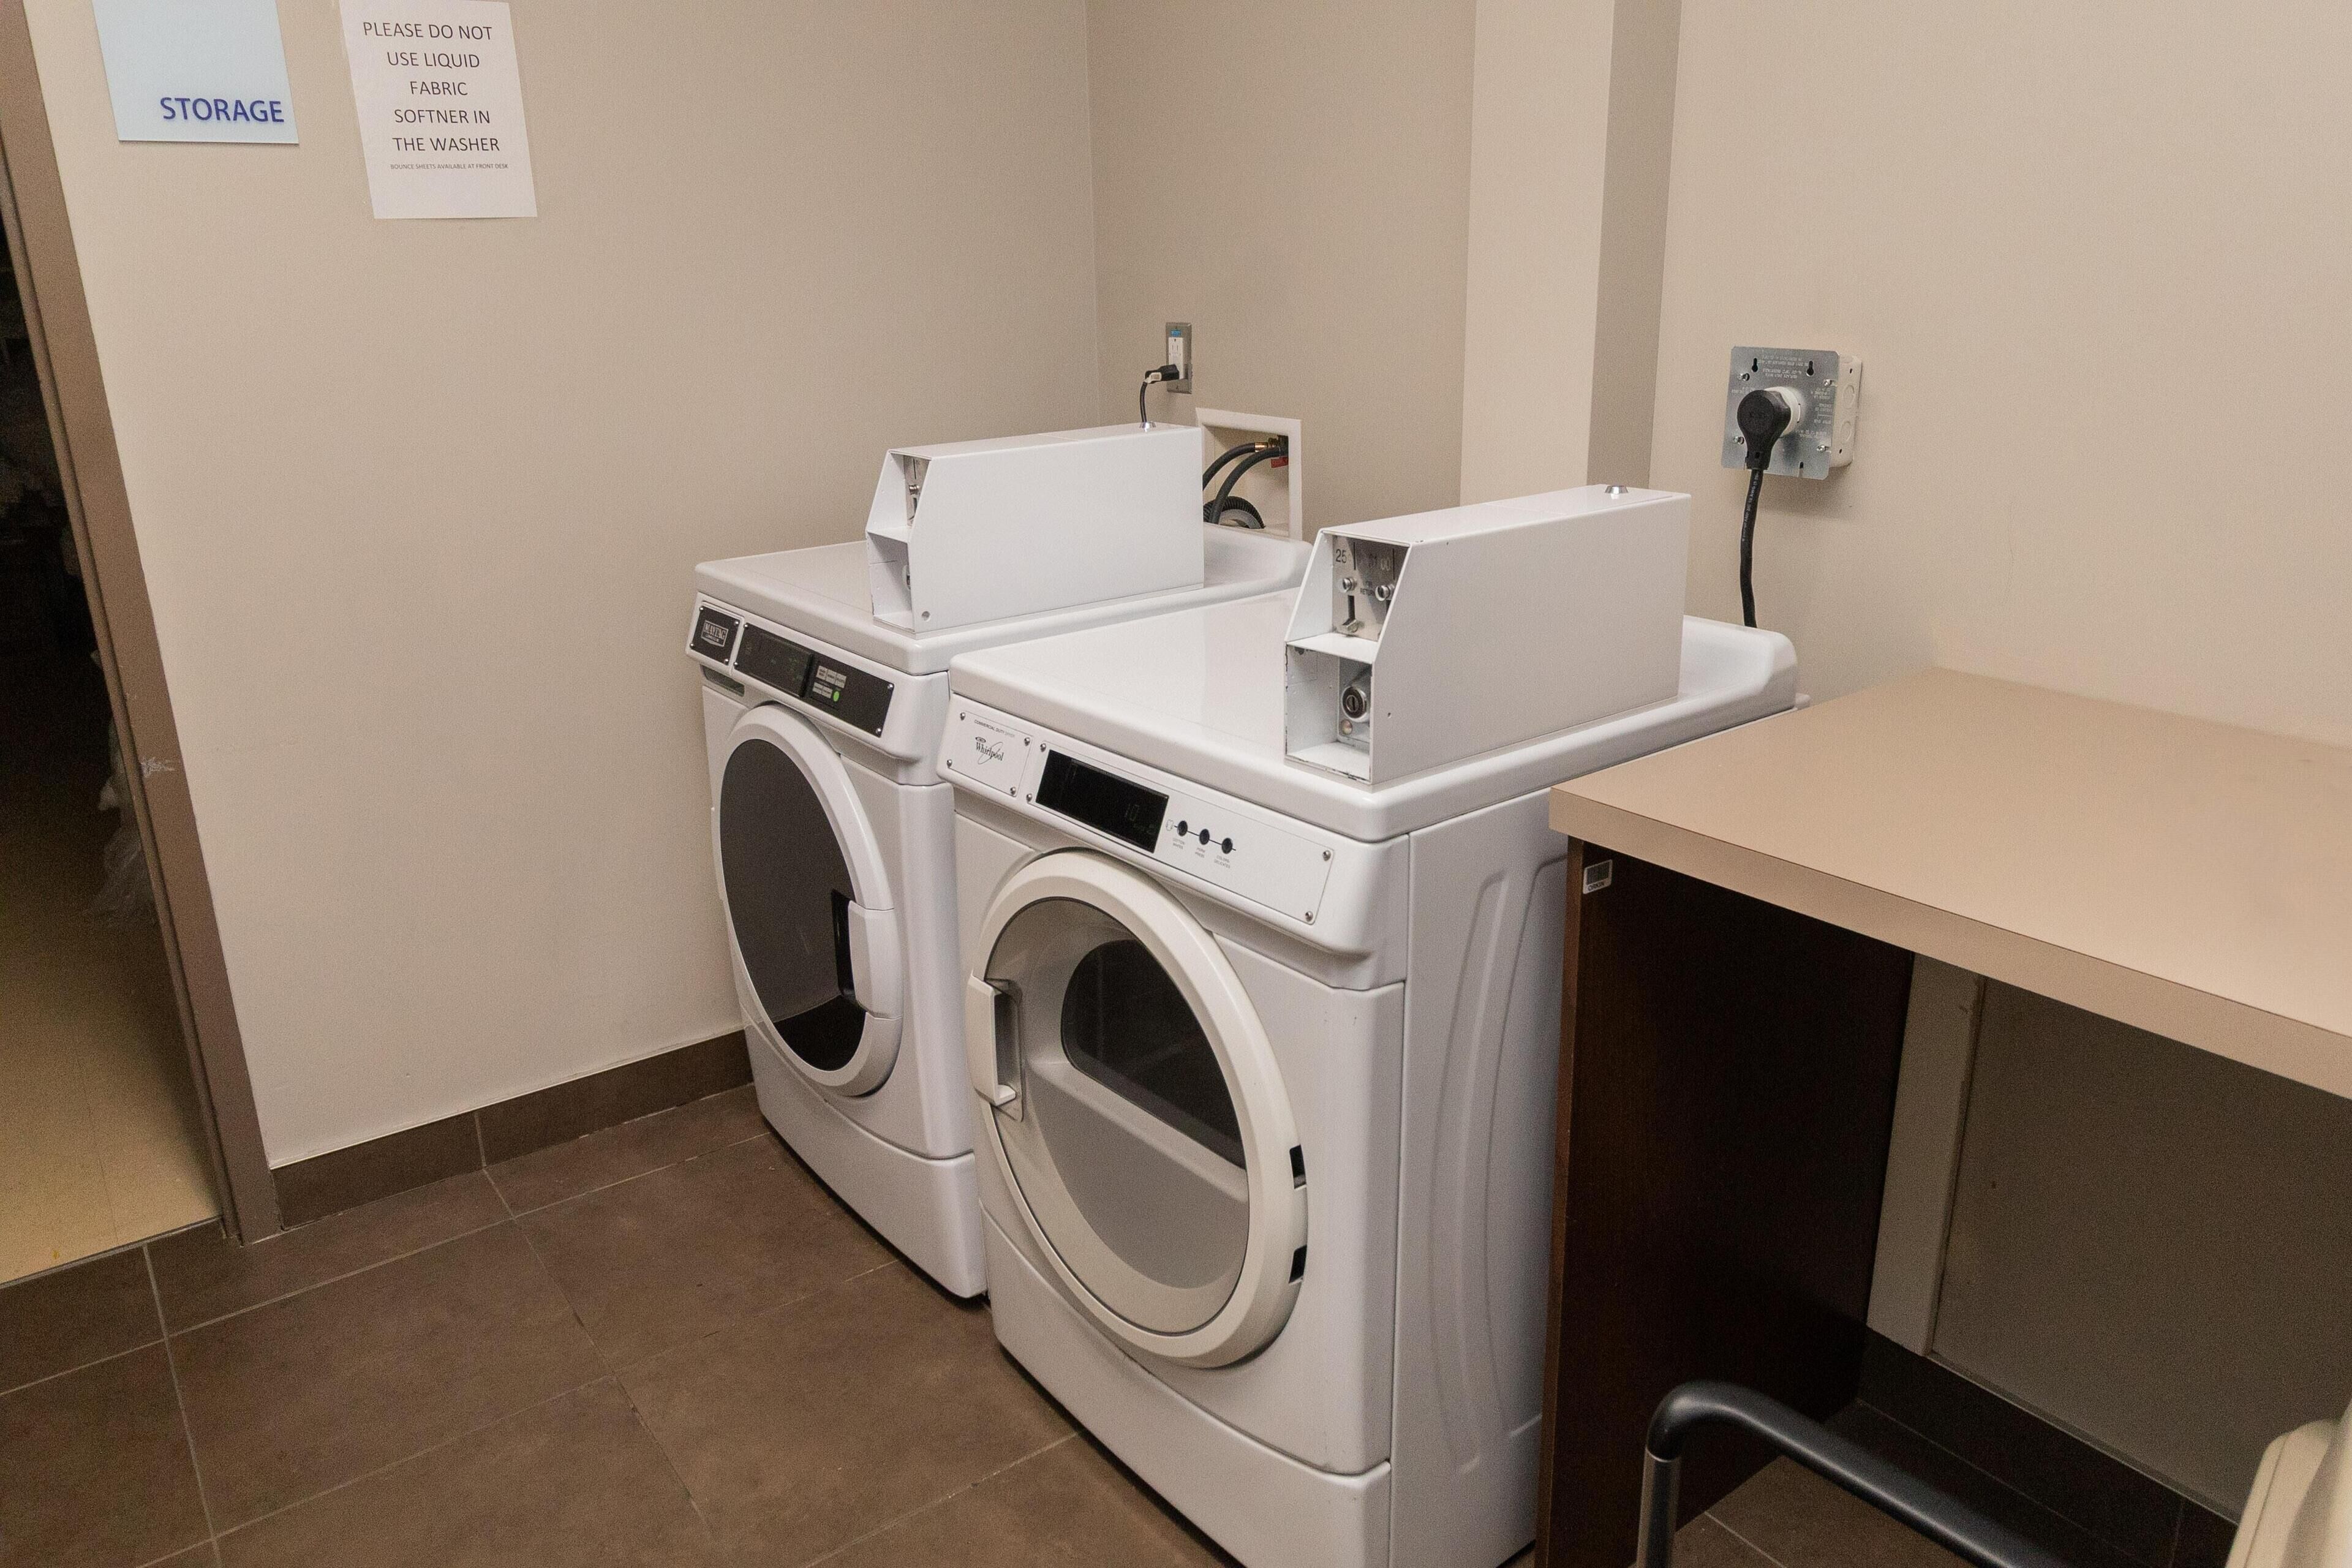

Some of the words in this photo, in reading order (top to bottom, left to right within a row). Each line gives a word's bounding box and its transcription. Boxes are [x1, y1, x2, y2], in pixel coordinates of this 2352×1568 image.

[363, 22, 424, 37] PLEASE
[428, 24, 453, 39] DO
[459, 26, 492, 40] NOT
[387, 52, 419, 66] USE
[424, 53, 480, 69] LIQUID
[410, 81, 468, 96] FABRIC
[160, 97, 285, 123] STORAGE
[394, 109, 469, 123] SOFTNER
[473, 110, 490, 124] IN
[392, 138, 426, 151] THE
[430, 138, 500, 151] WASHER
[1335, 549, 1348, 564] 25
[704, 623, 726, 640] MAYTAG
[976, 742, 1005, 761] Whirlpool
